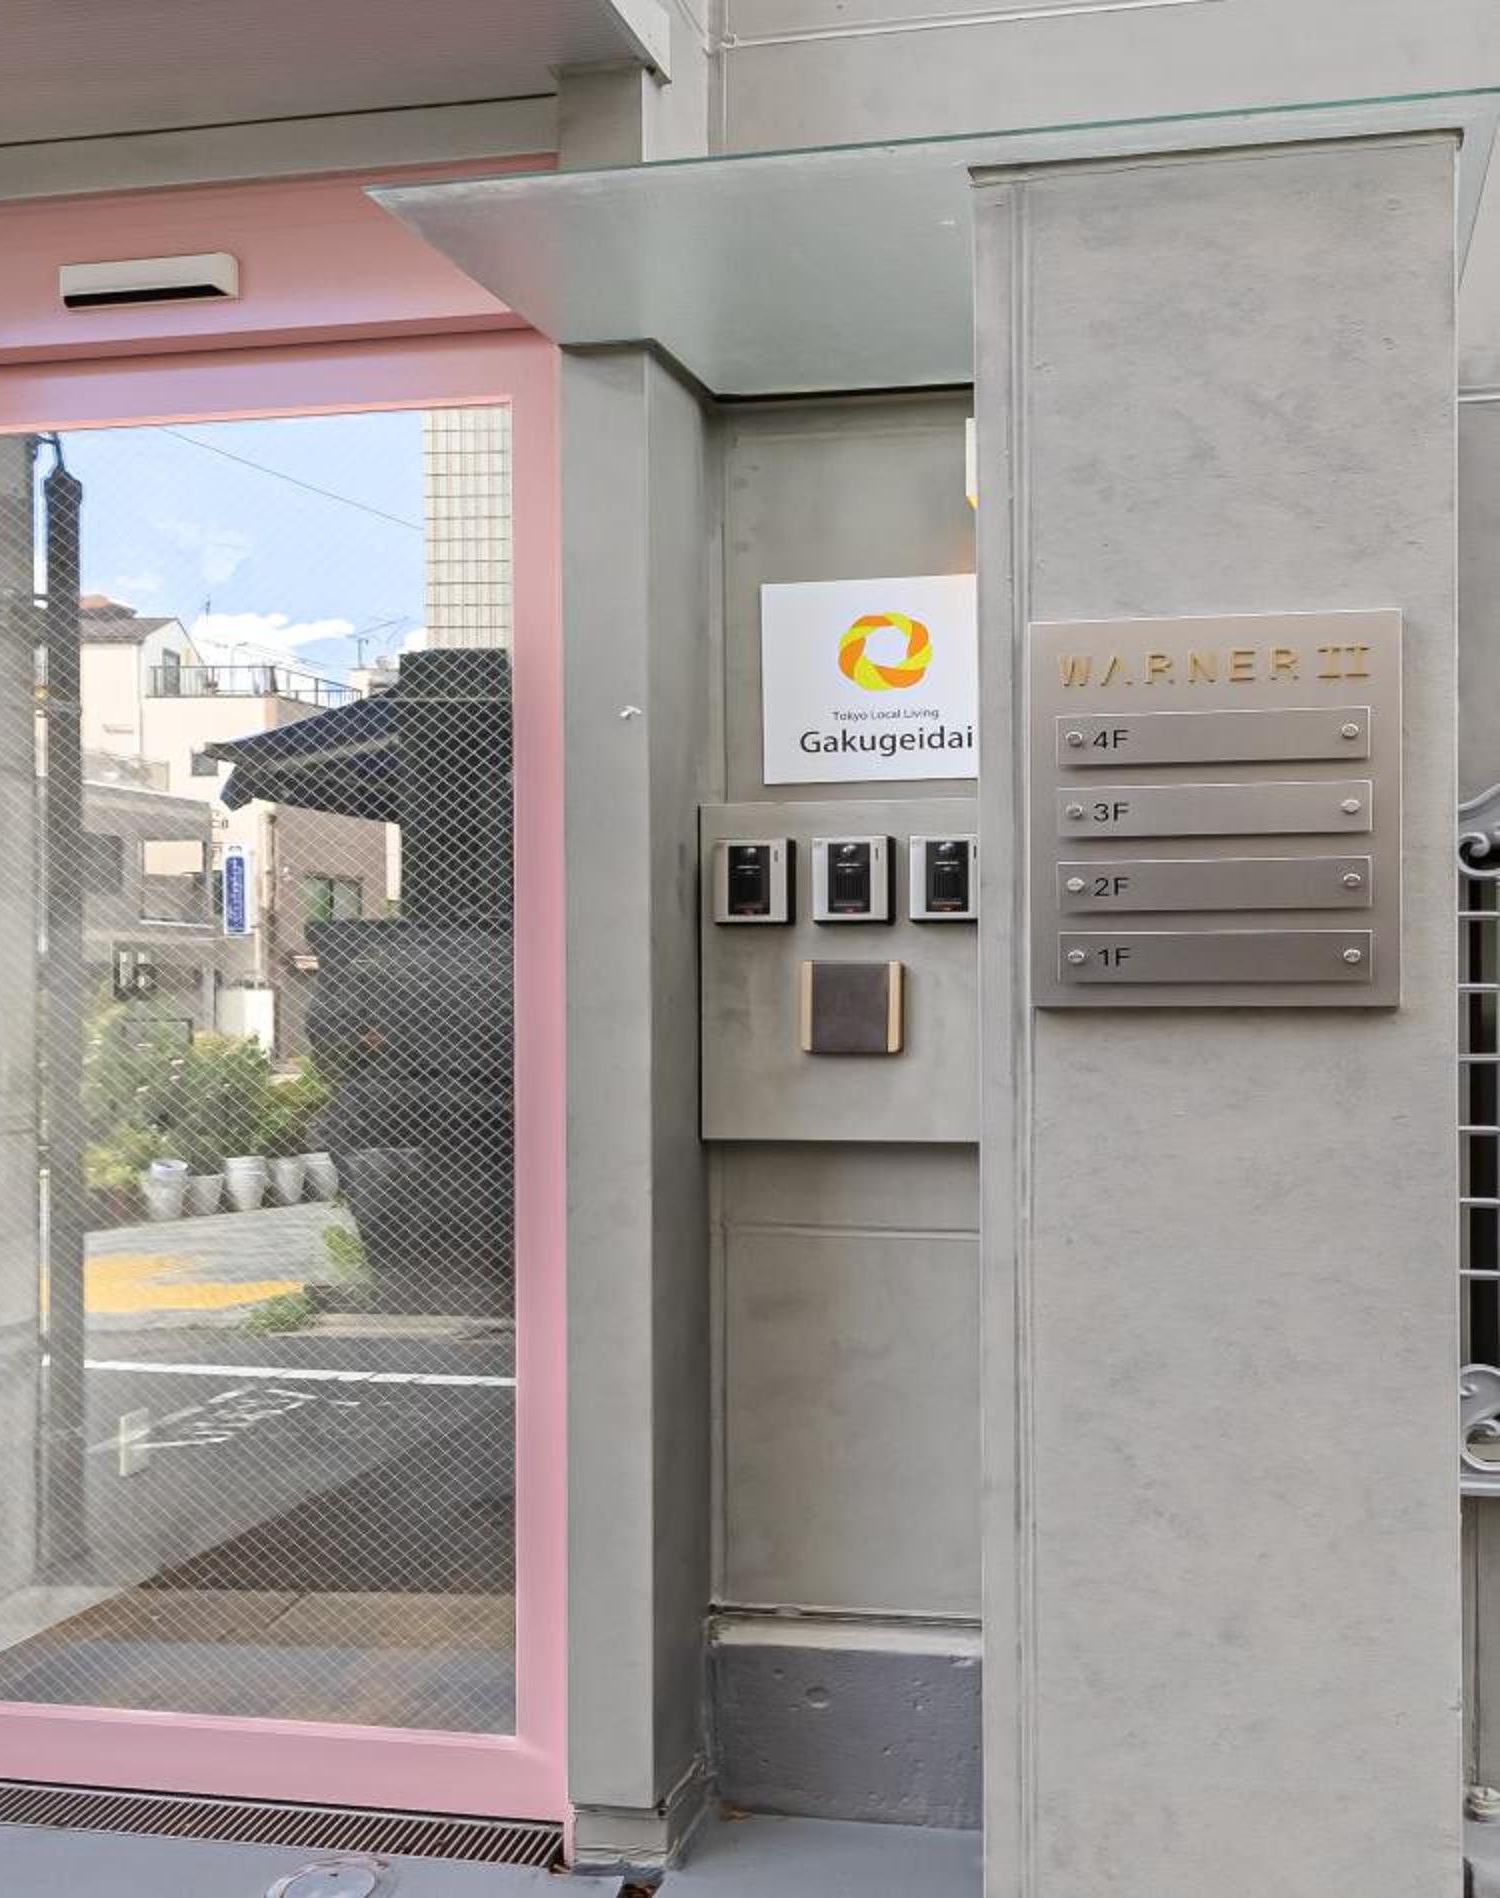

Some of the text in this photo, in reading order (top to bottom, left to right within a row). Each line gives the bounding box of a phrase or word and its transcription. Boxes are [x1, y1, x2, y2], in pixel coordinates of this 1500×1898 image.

[1059, 649, 1301, 687] WARNER
[833, 708, 940, 721] Tokyo Local Living
[799, 725, 974, 757] Gakugeidai
[1092, 729, 1130, 749] 4F
[1092, 802, 1130, 822] 3F
[1092, 877, 1131, 897] 2F
[1096, 948, 1132, 967] 1F
